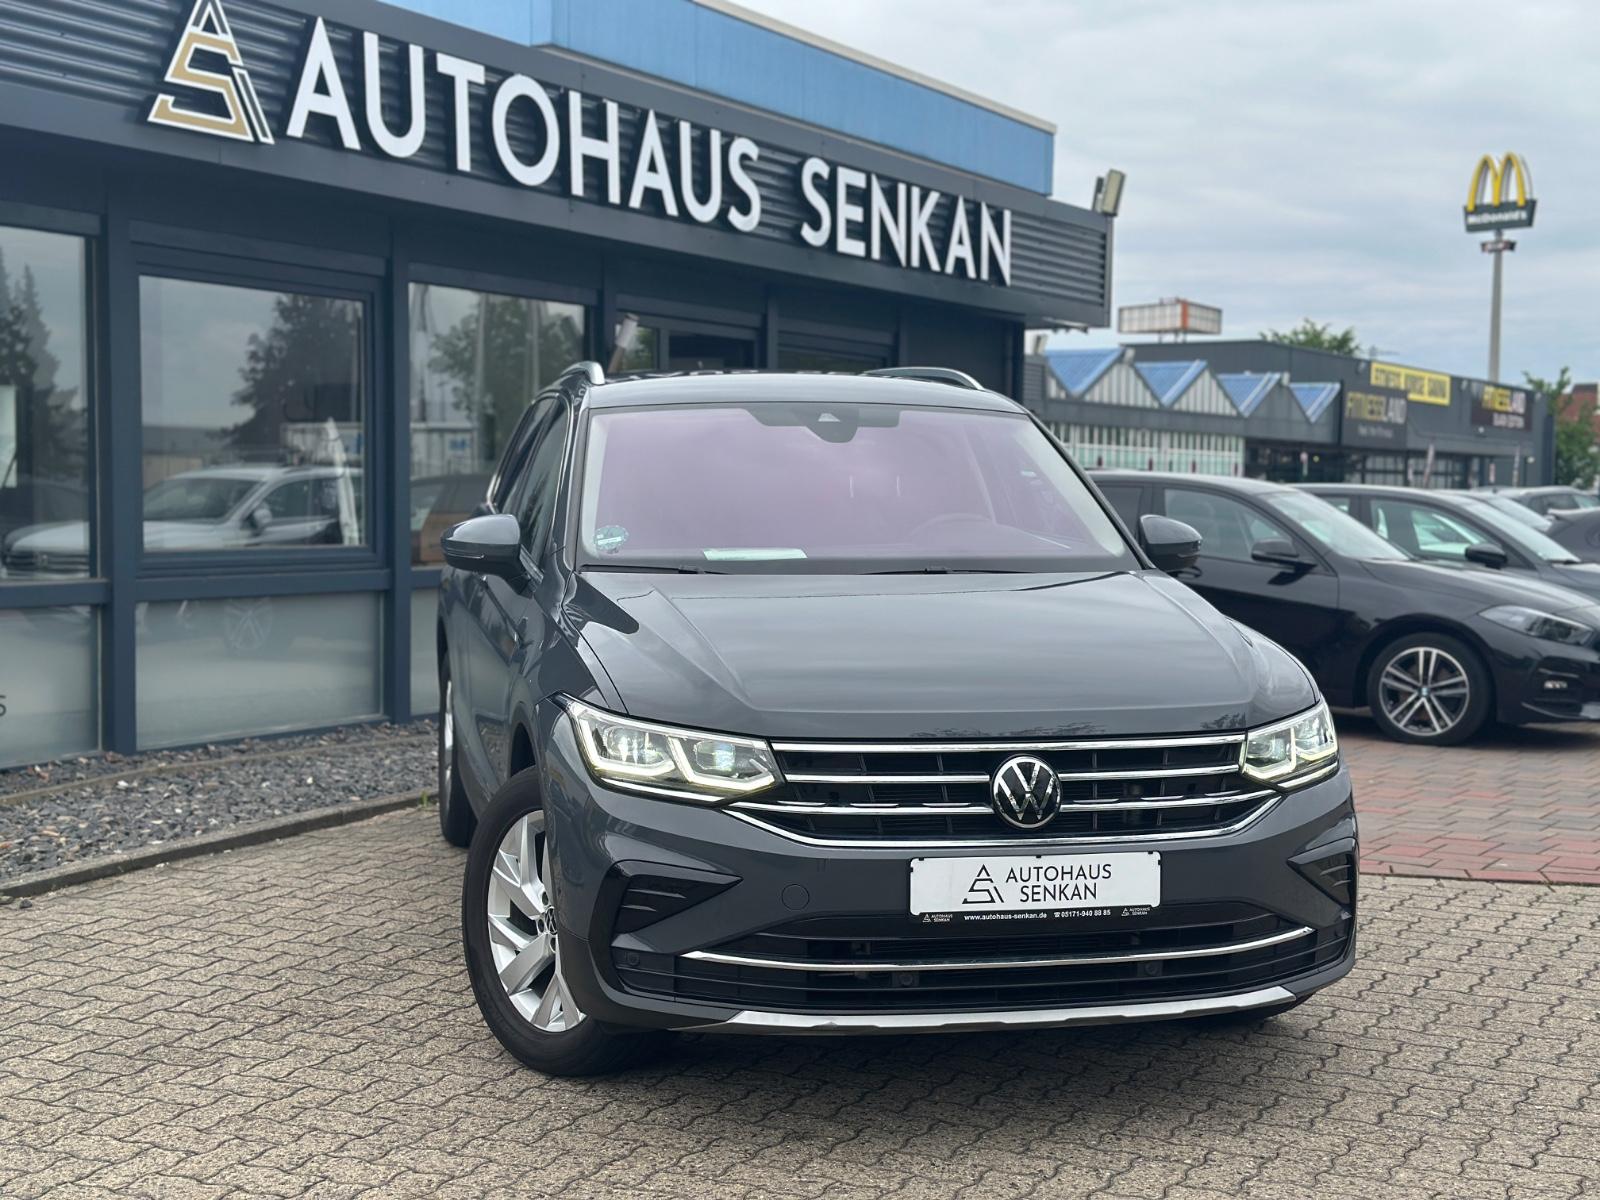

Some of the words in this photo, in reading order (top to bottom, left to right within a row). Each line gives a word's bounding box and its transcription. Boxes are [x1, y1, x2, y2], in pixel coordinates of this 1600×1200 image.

[286, 16, 762, 232] AUTOHAUS
[801, 157, 1011, 287] SENKAN
[1005, 863, 1113, 884] AUTOHAUS
[1020, 882, 1098, 903] SENKAN
[963, 911, 1048, 921] www.autohaus-senkan.de
